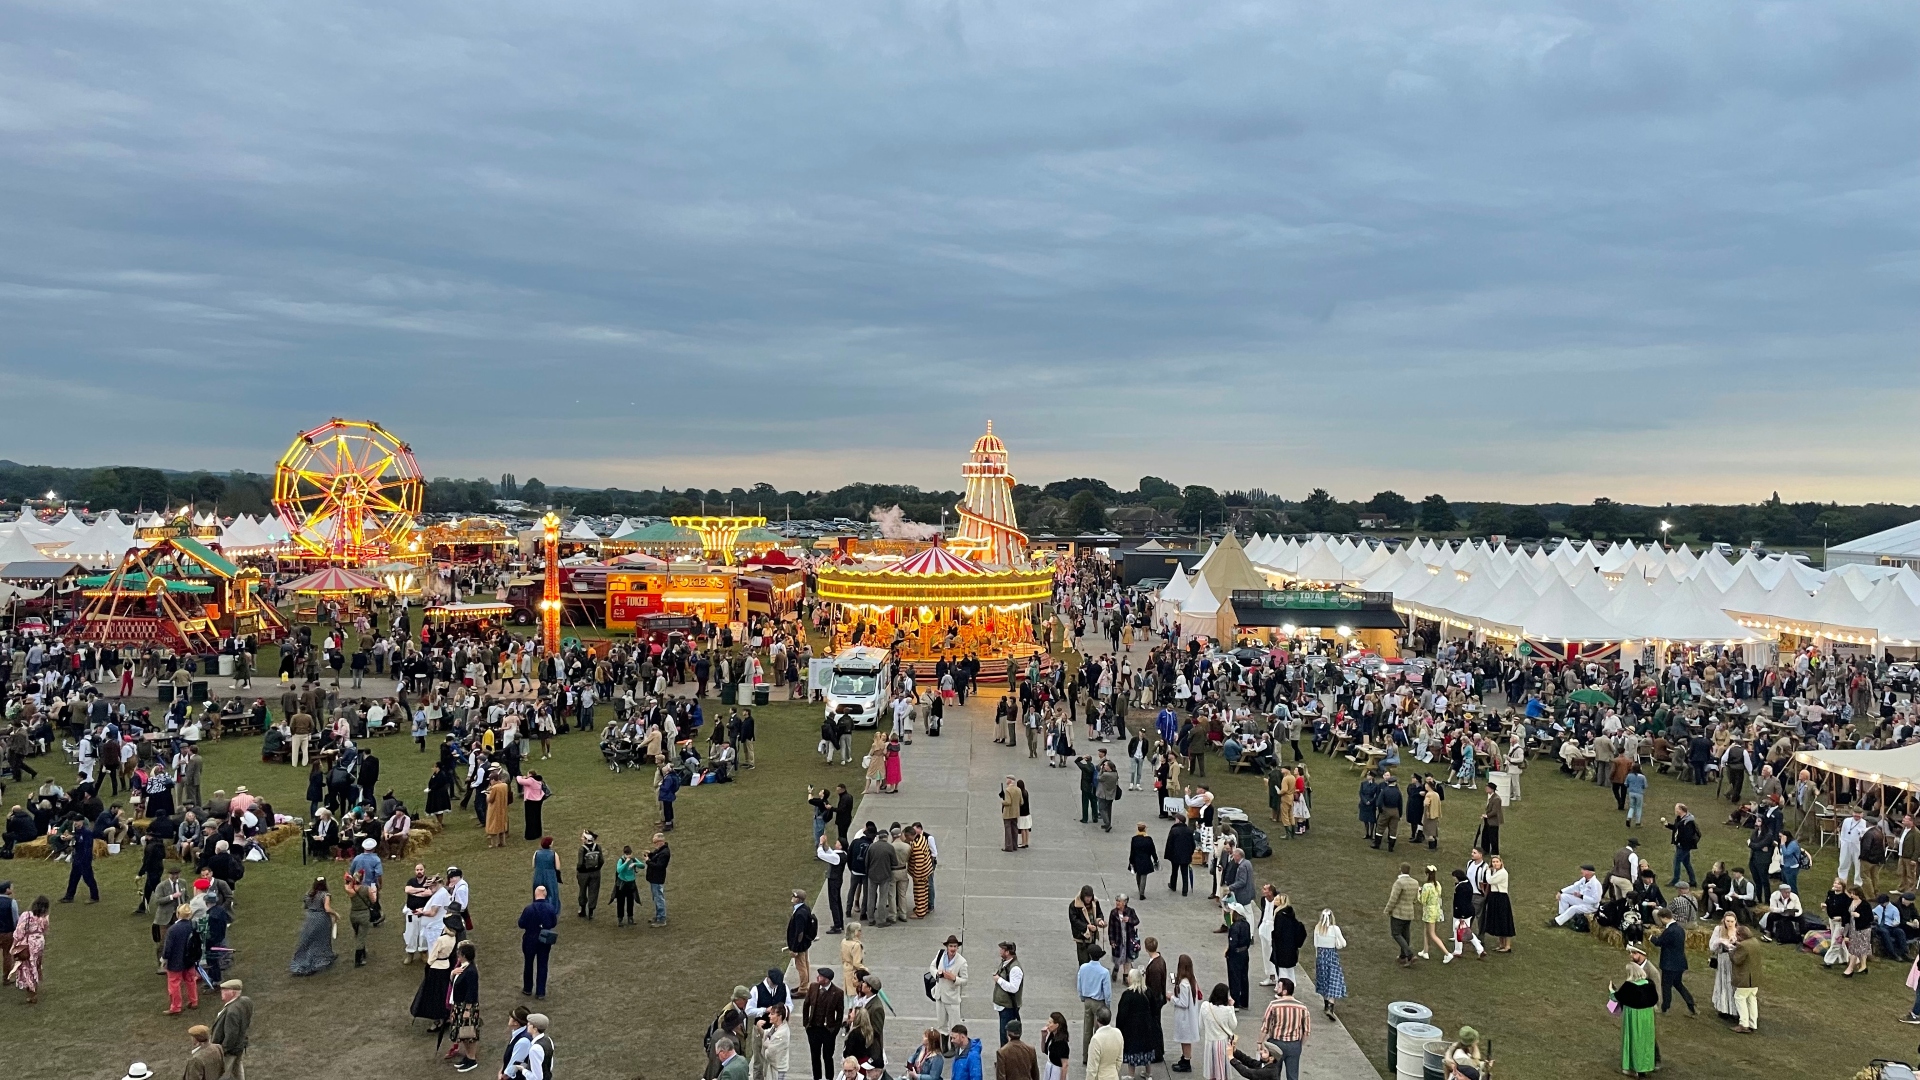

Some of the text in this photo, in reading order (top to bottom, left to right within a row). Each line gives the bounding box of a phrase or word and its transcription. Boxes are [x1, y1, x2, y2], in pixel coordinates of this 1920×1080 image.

[670, 576, 724, 589] TOKENS
[626, 596, 648, 607] TOKEN
[1299, 592, 1325, 600] TOTAL
